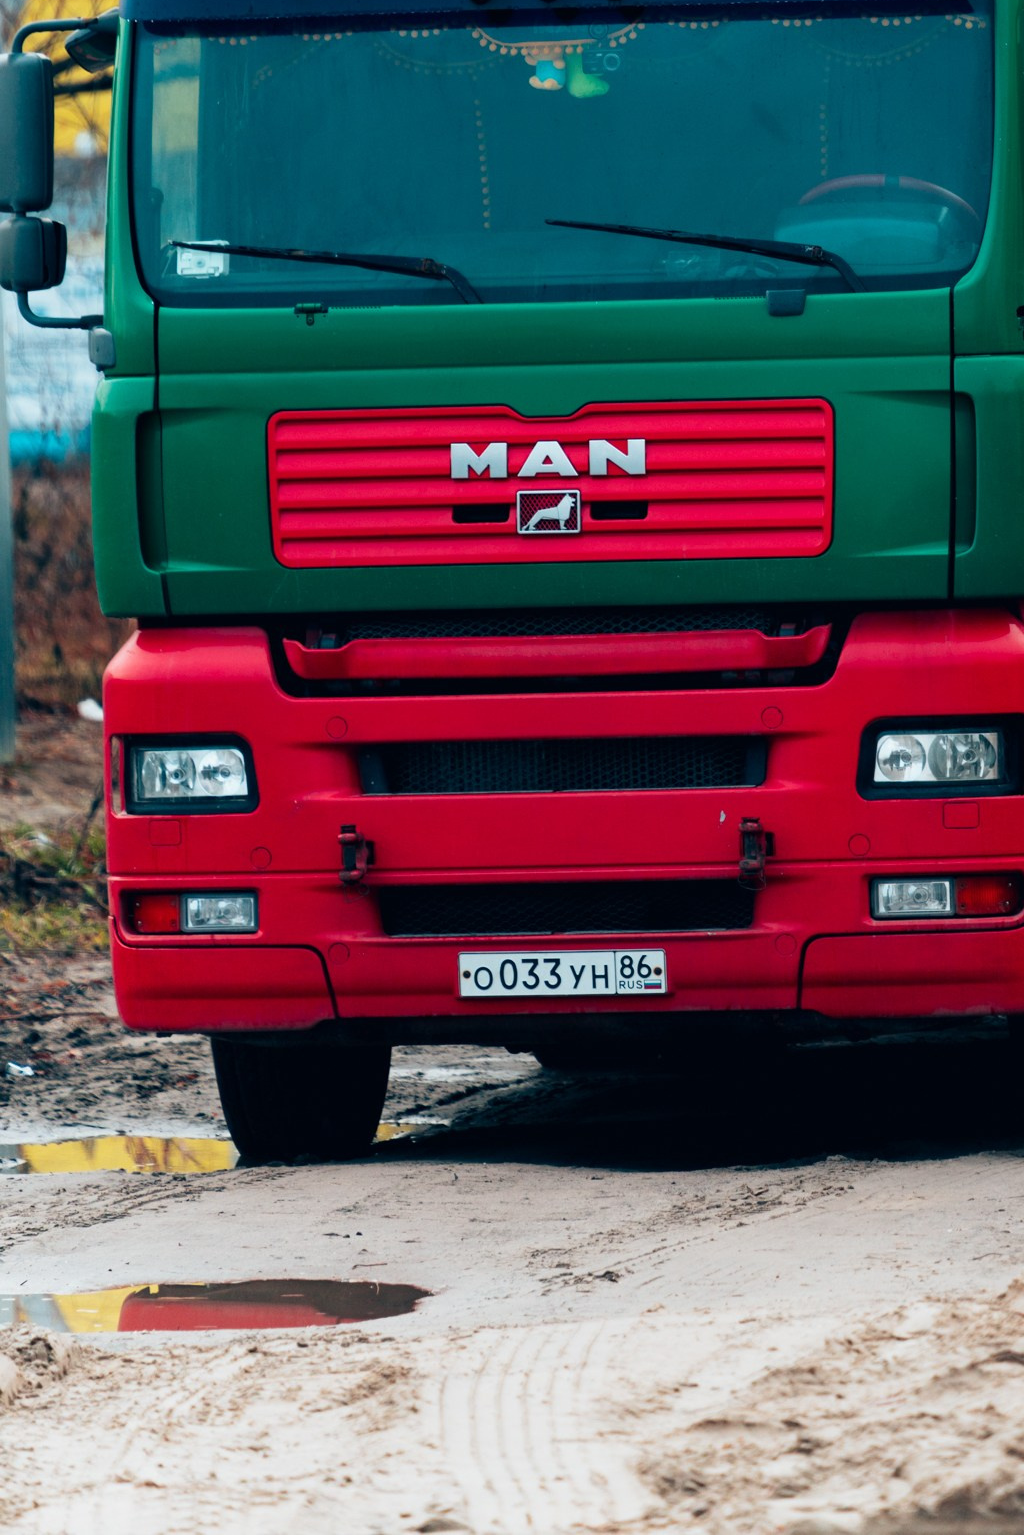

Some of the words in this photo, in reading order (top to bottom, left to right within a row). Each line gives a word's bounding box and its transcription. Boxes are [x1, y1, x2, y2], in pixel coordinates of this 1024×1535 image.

[450, 439, 646, 479] MAN
[620, 955, 651, 979] 86
[618, 980, 643, 990] RUS
